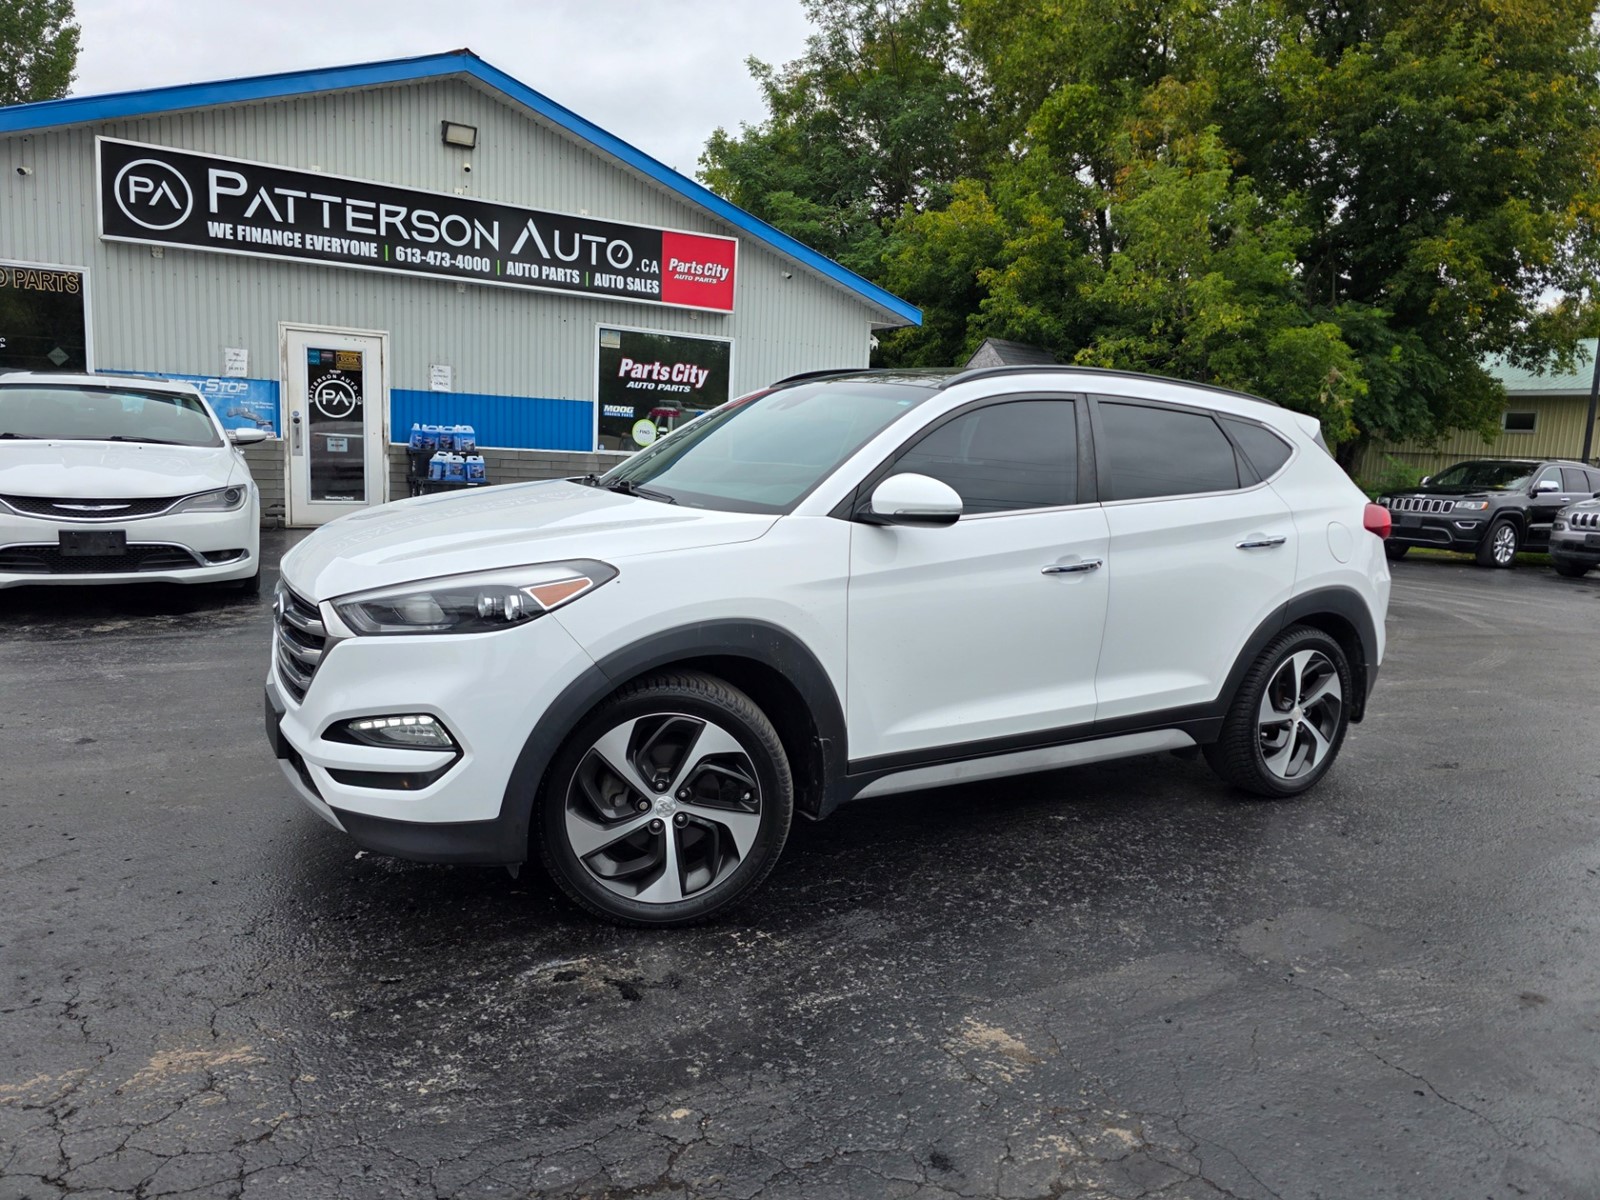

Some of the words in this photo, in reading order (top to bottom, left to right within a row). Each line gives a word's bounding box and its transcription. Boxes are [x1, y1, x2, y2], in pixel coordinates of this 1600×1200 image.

[208, 168, 499, 252] PATTERSON
[510, 218, 634, 270] AUTO
[207, 221, 234, 240] WE
[237, 224, 302, 248] FINANCE
[305, 233, 378, 258] EVERYONE
[395, 245, 491, 273] 613-473-4000
[506, 261, 539, 279] AUTO
[541, 265, 580, 284] PARTS
[593, 272, 625, 289] AUTO
[626, 276, 660, 294] SALES
[14, 269, 79, 293] PARTS
[674, 273, 693, 281] AUTO
[694, 276, 717, 284] PARTS
[626, 381, 655, 389] AUTO
[657, 384, 691, 392] PARTS
[604, 405, 634, 413] MOOG
